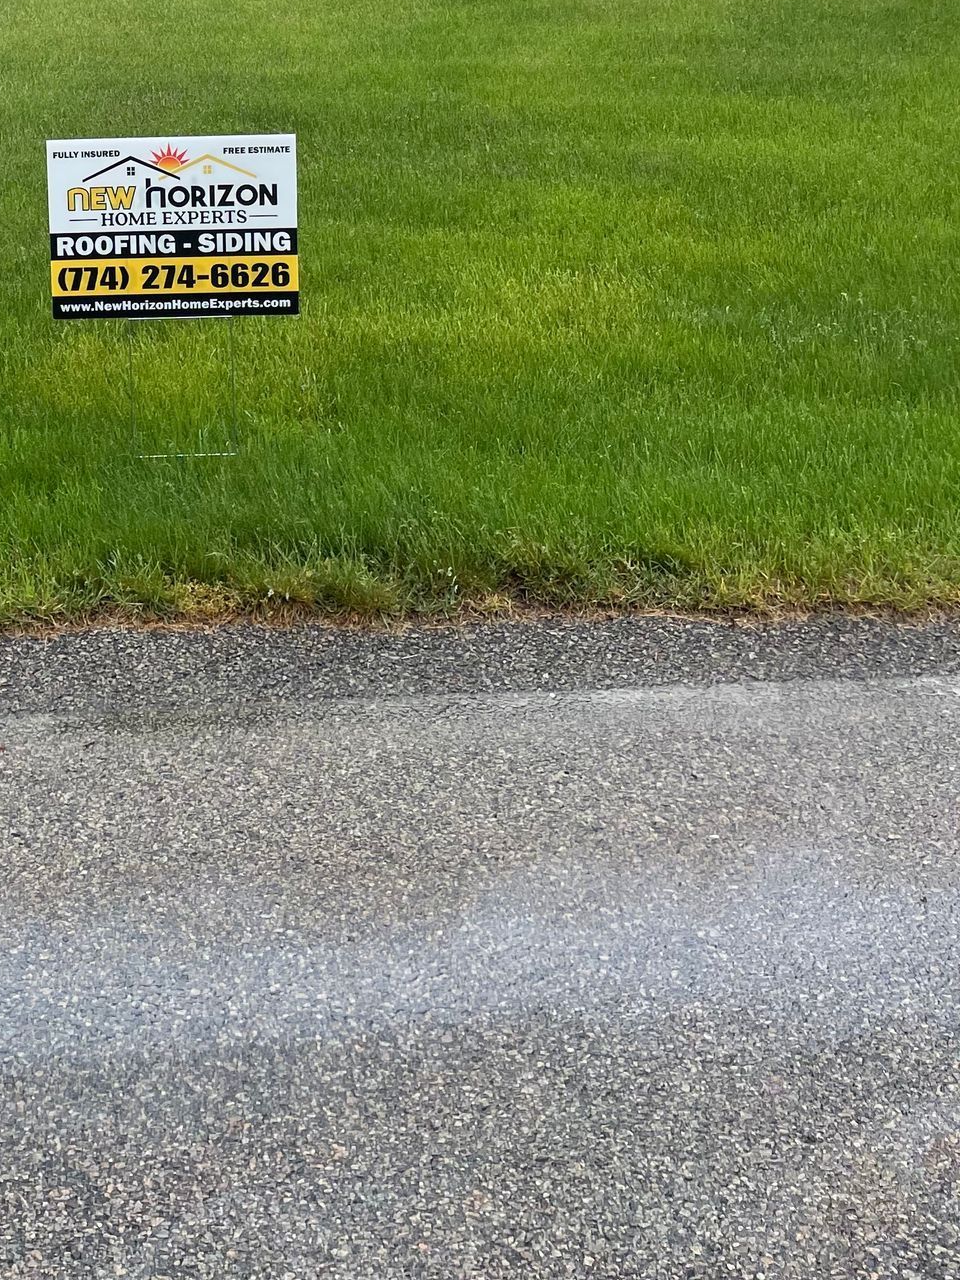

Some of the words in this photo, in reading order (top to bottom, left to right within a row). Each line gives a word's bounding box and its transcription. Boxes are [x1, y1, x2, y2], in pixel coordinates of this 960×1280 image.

[52, 150, 79, 159] FULLY
[81, 150, 121, 158] INSURED
[223, 147, 246, 155] FREE
[248, 145, 291, 154] ESTIMATE
[101, 212, 157, 227] HOME
[162, 210, 248, 226] EXPERTS
[56, 234, 176, 257] ROOFING
[197, 231, 291, 253] SIDING
[57, 266, 130, 292] (774)
[141, 262, 290, 290] 274-6626
[60, 298, 291, 313] www.NewHorizonHomeExperts.com
